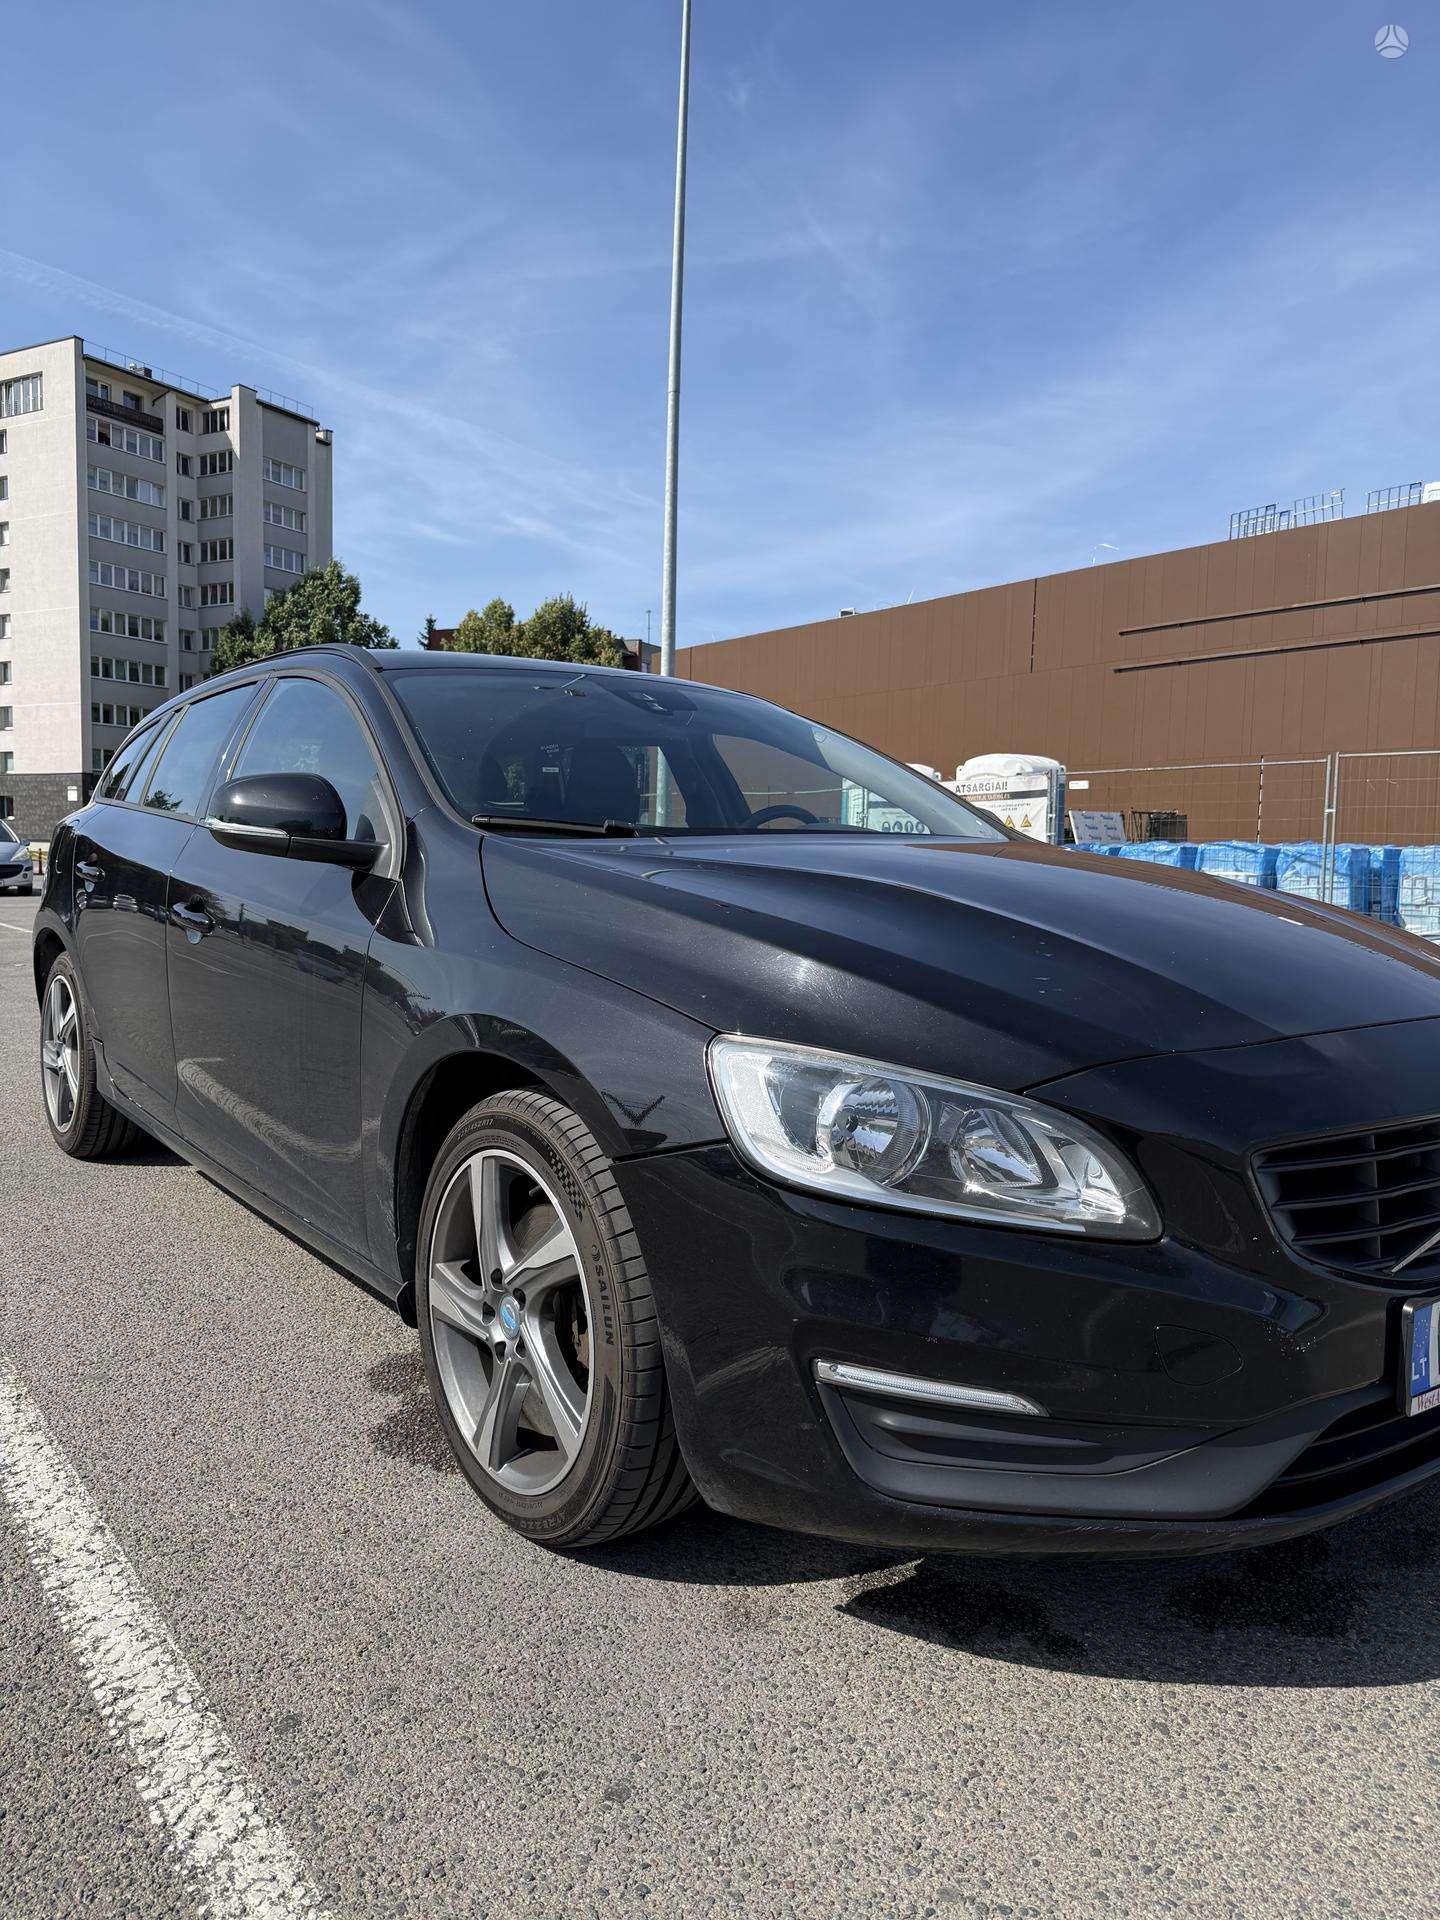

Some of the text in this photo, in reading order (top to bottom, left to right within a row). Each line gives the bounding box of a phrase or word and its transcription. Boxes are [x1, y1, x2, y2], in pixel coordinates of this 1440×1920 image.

[955, 781, 1008, 794] ATSARGIAI!
[595, 1264, 615, 1346] SAILUN
[1411, 1357, 1427, 1380] LT
